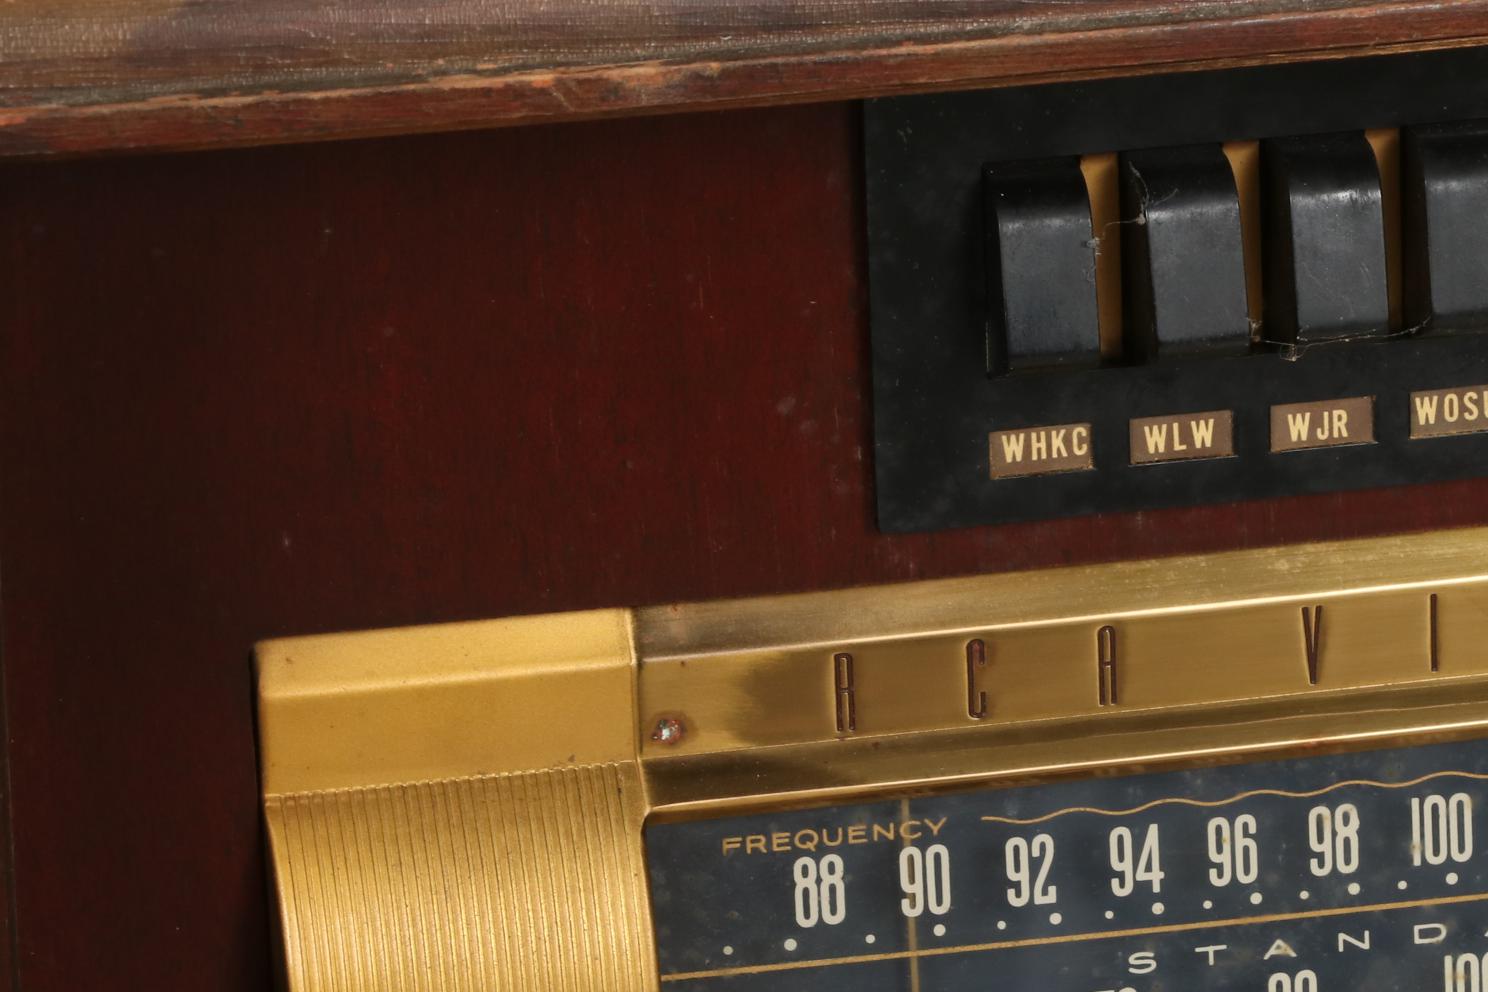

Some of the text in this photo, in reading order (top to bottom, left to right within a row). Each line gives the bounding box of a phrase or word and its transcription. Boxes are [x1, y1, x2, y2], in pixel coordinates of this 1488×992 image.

[1001, 426, 1089, 463] WHKC
[1144, 418, 1216, 455] WLW
[1287, 407, 1350, 443] WJR
[833, 624, 1118, 734] RCA
[722, 816, 949, 857] FREQUENCY
[794, 854, 846, 928] 88
[899, 844, 951, 918] 90
[1005, 833, 1057, 908] 92
[1109, 823, 1165, 898] 94
[1207, 813, 1259, 887] 96
[1308, 803, 1361, 877] 98
[1411, 792, 1473, 867] 100
